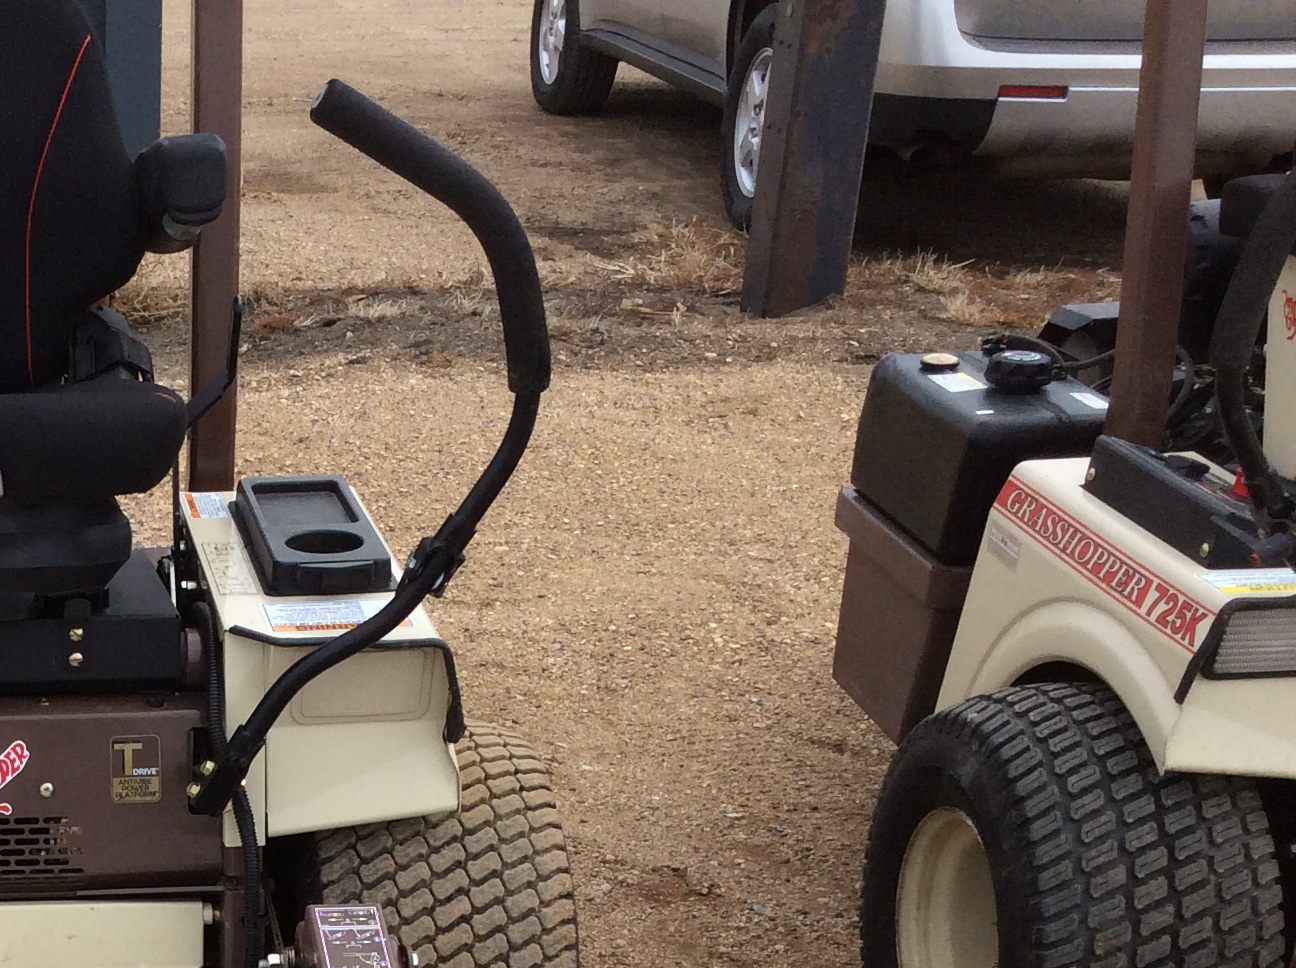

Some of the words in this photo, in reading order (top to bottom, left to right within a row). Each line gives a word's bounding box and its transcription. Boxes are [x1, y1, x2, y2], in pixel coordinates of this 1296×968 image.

[1006, 488, 1147, 603] GRASSHOPPER
[1145, 584, 1209, 648] 725K
[132, 767, 157, 776] DRIVE
